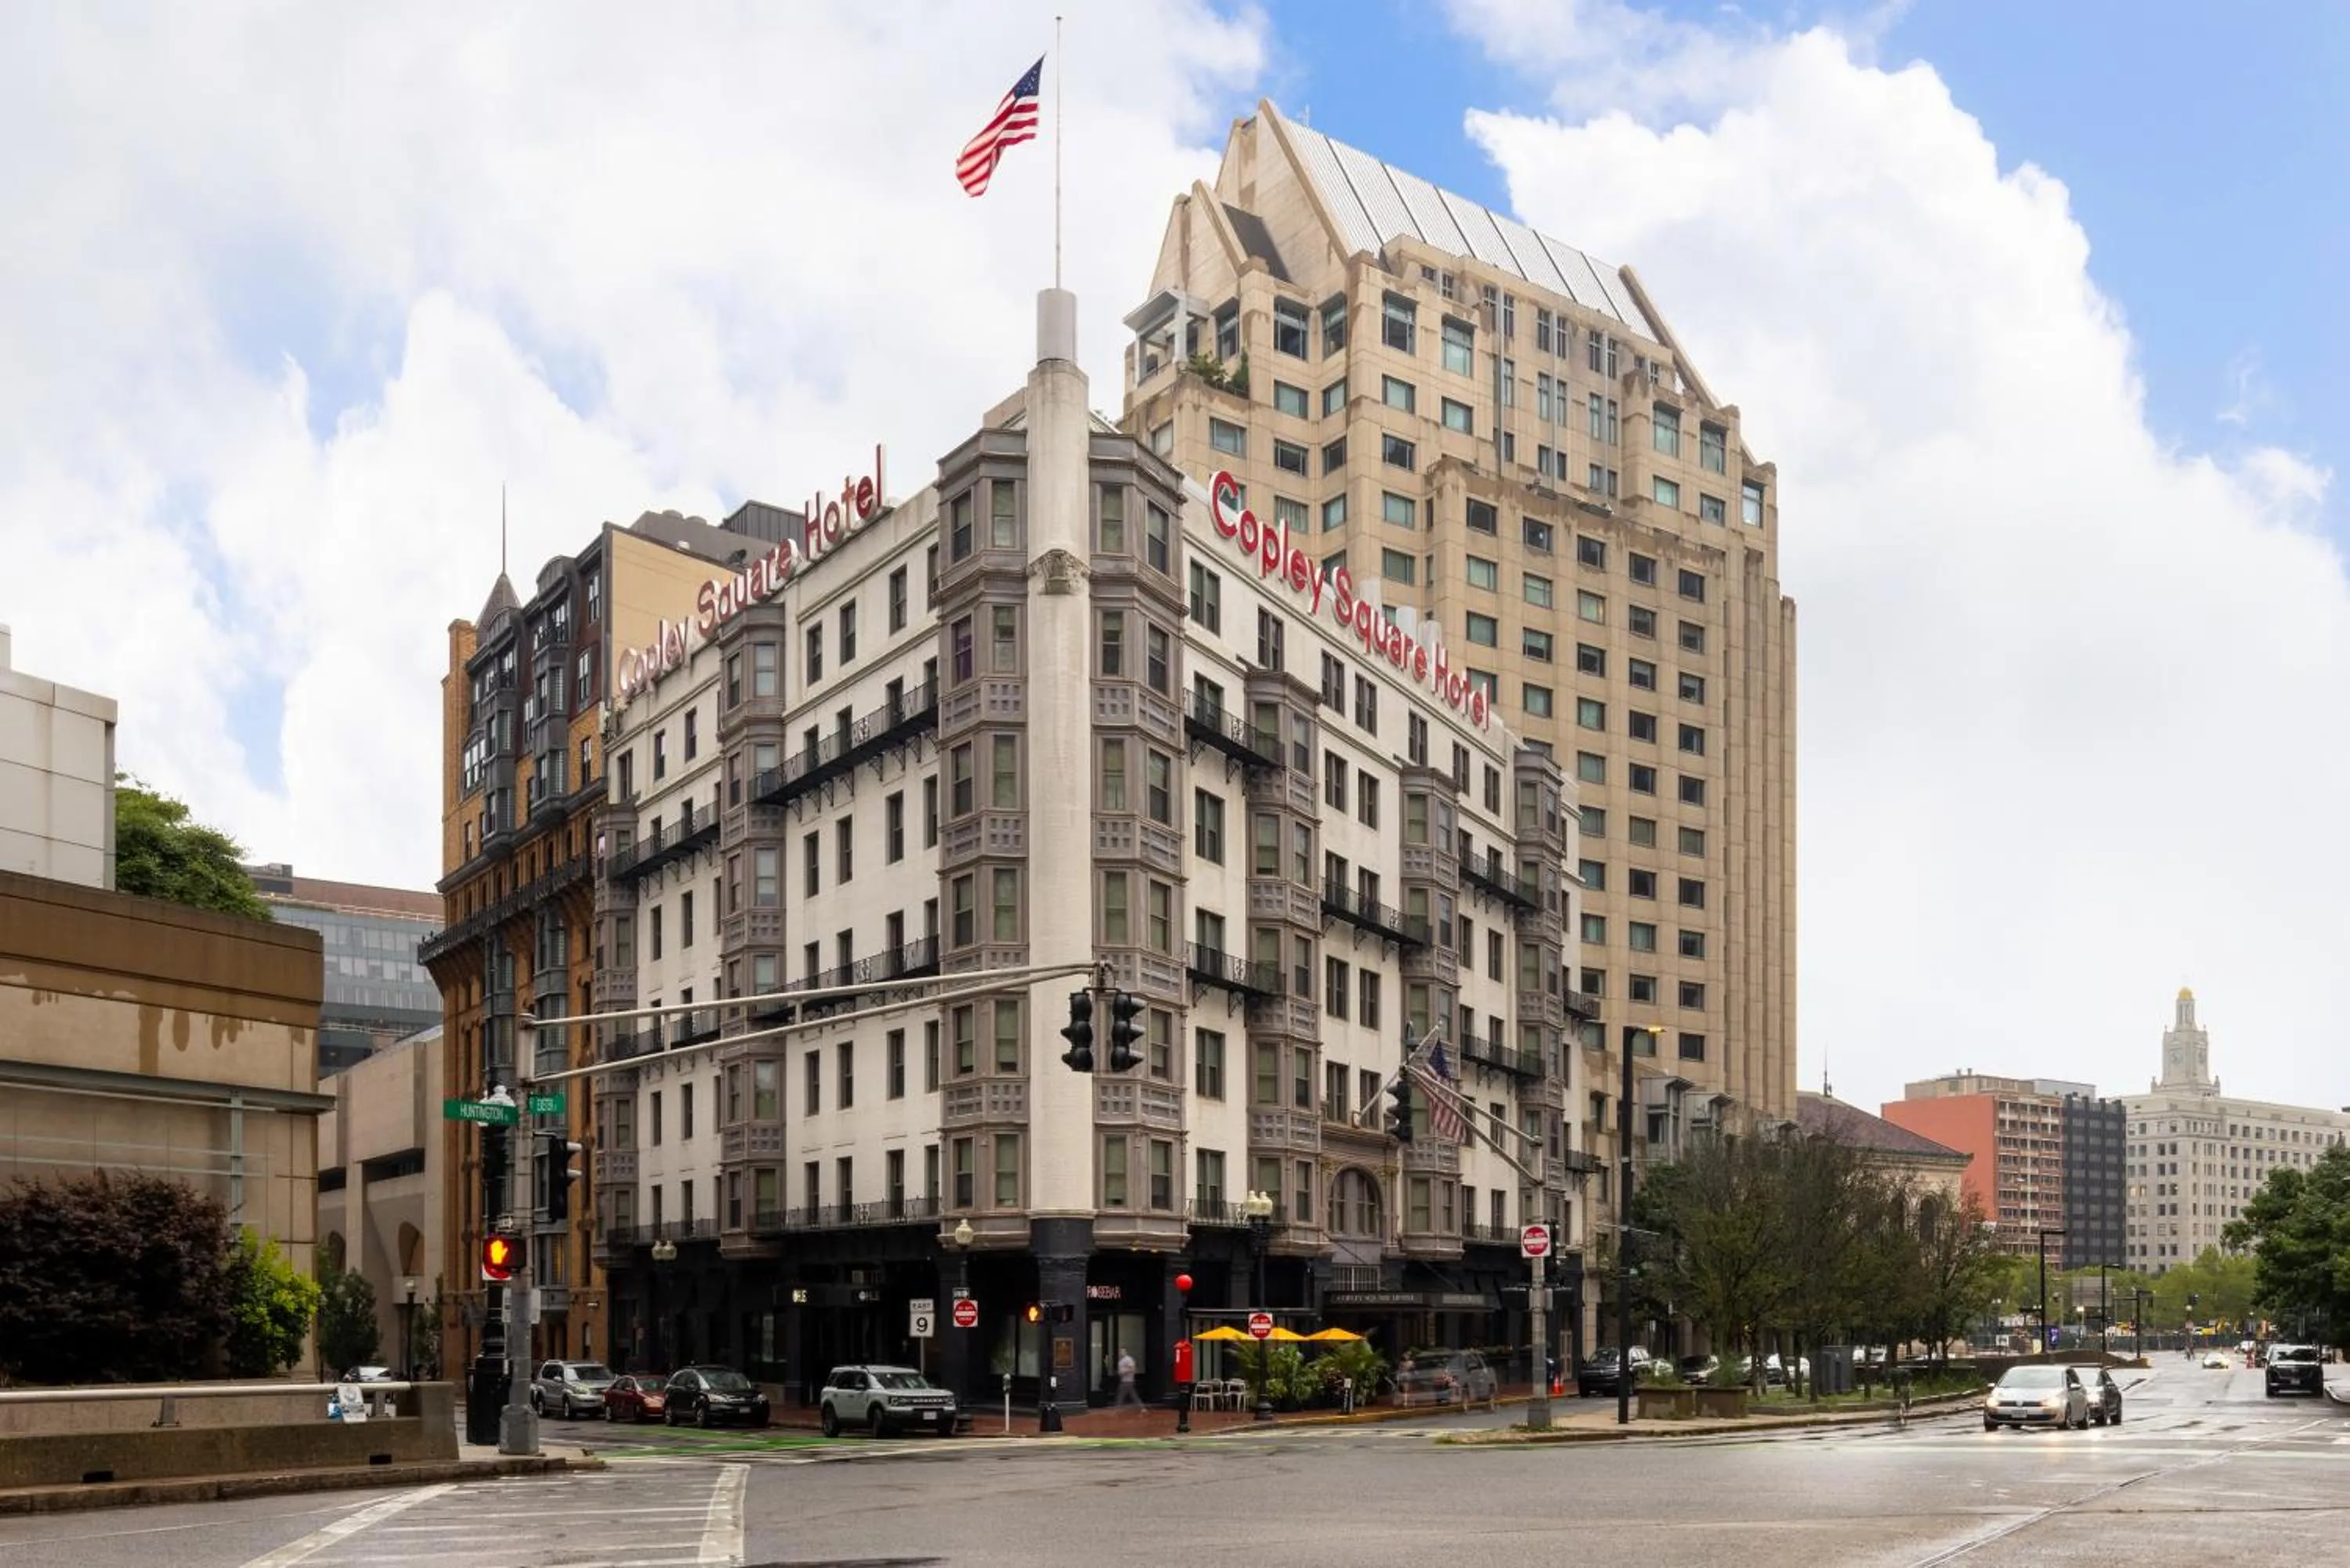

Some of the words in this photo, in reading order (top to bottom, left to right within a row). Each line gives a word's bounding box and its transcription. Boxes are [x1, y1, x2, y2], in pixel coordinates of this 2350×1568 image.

[618, 616, 692, 695] Copley
[697, 538, 798, 637] Square
[804, 443, 886, 561] Hotel
[1209, 471, 1325, 616] Copley
[1333, 566, 1429, 684] Square
[1431, 640, 1490, 733] Hotel
[460, 1102, 504, 1121] HUNTINGTON
[916, 1317, 928, 1333] 9
